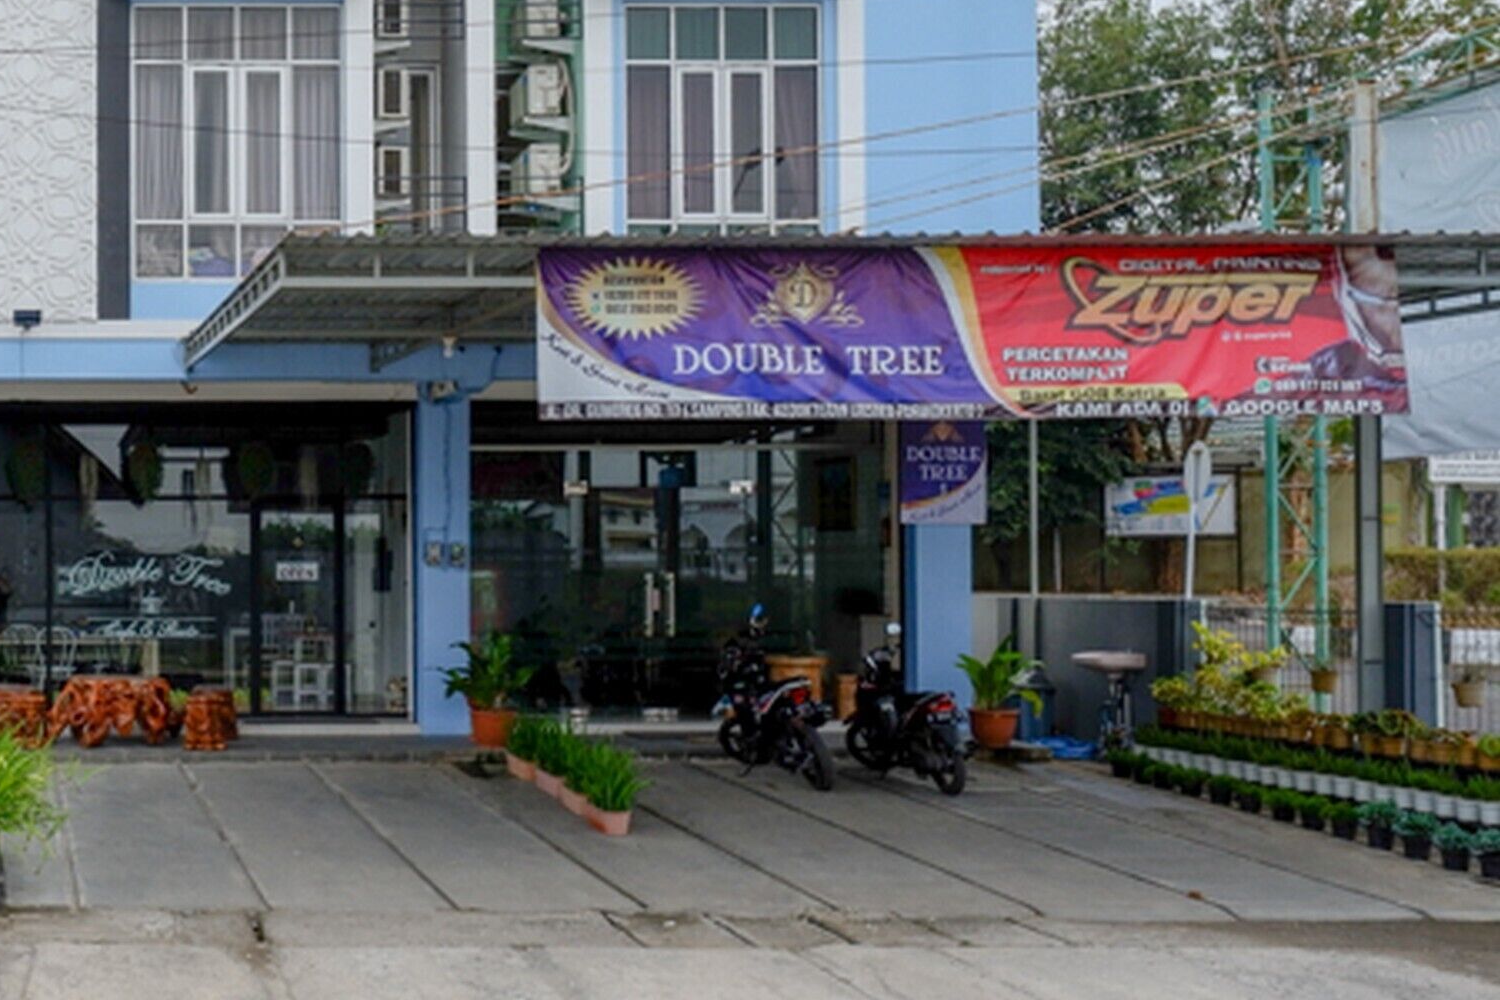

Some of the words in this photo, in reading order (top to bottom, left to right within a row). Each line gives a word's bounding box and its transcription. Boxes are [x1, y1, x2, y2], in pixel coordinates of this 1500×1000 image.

[1118, 258, 1205, 272] DIGITAL
[672, 342, 826, 376] DOUBLE
[846, 344, 946, 376] TREE
[1002, 346, 1129, 362] PERCETAKAN
[1006, 364, 1129, 381] TERKOMPLIT
[1055, 401, 1113, 417] KAMI
[1119, 401, 1162, 416] ADA
[1169, 400, 1189, 415] DI
[1225, 399, 1318, 415] GOOGLE
[1323, 398, 1384, 414] MAPS
[905, 445, 981, 462] DOUBLE
[919, 464, 967, 481] TREE
[168, 552, 232, 596] Tree
